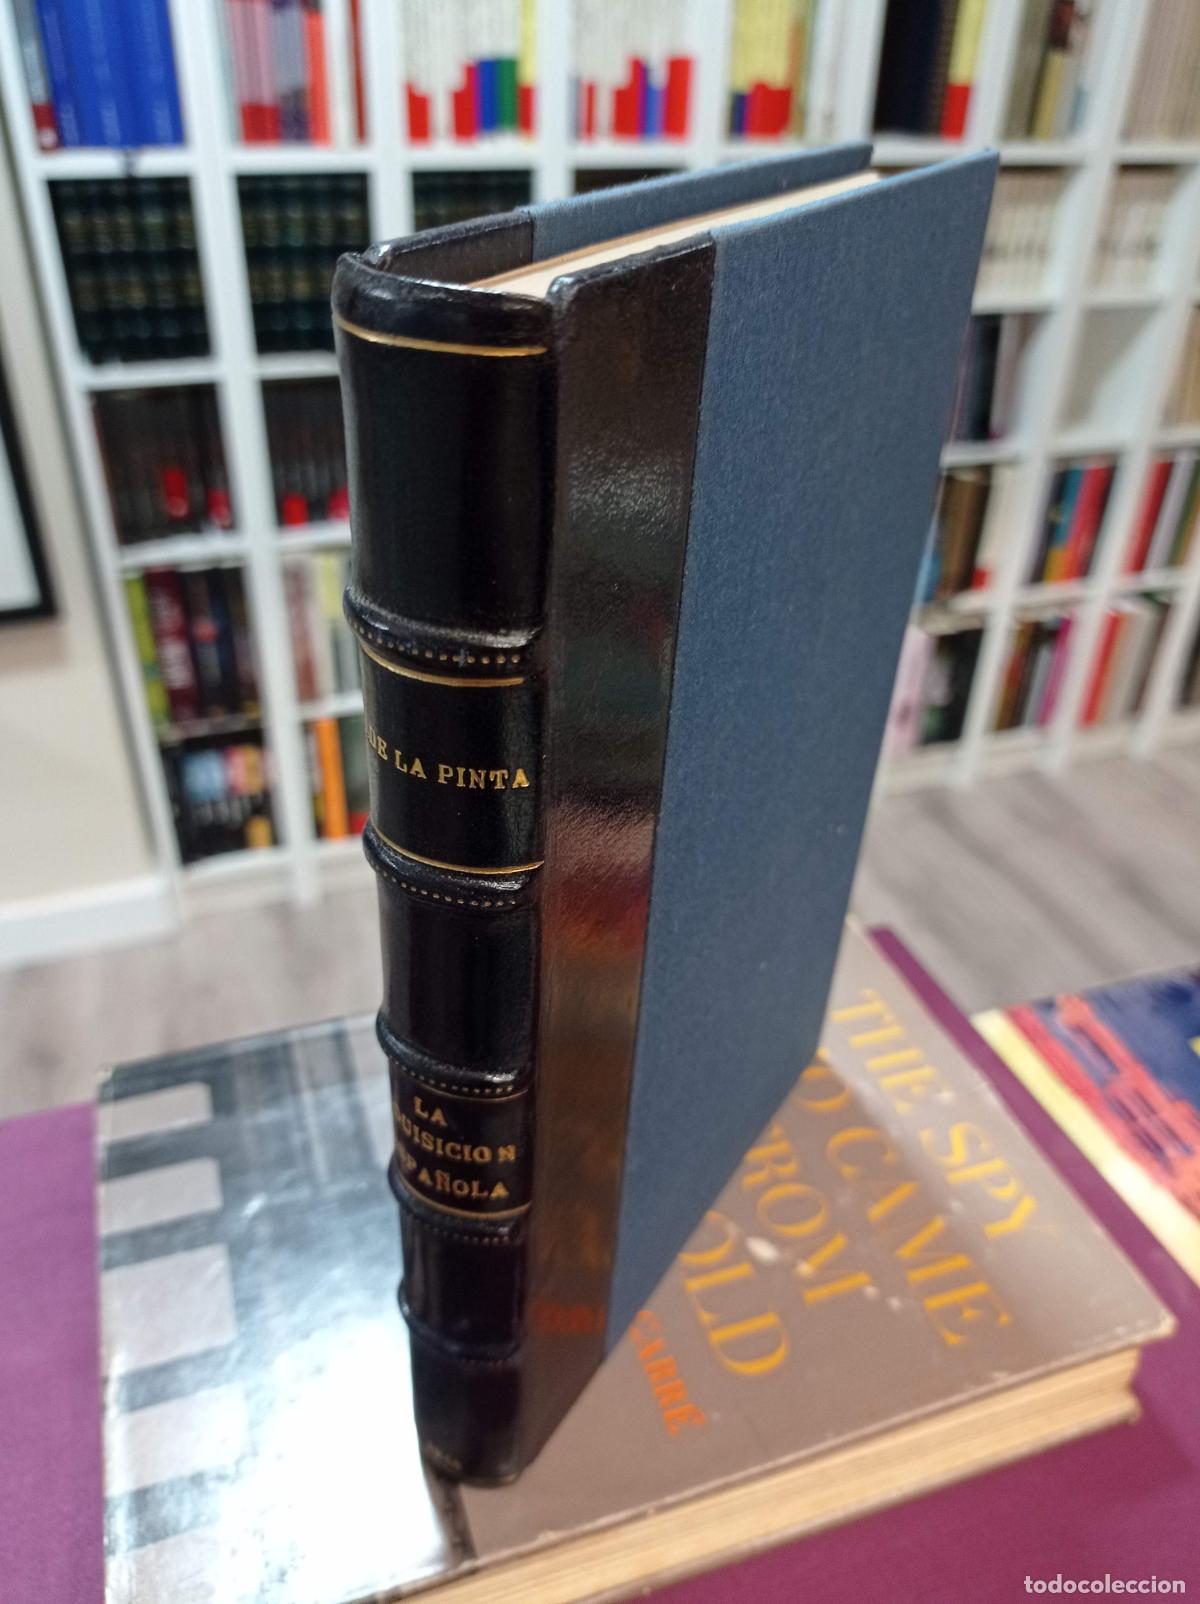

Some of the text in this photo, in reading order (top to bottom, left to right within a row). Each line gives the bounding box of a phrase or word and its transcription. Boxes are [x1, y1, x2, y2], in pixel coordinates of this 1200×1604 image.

[394, 749, 427, 780] LA
[437, 763, 531, 790] PINTA
[413, 1096, 448, 1128] LA
[831, 987, 1055, 1240] THE SPY
[741, 1122, 873, 1305] ROM
[826, 1125, 1010, 1346] CAME
